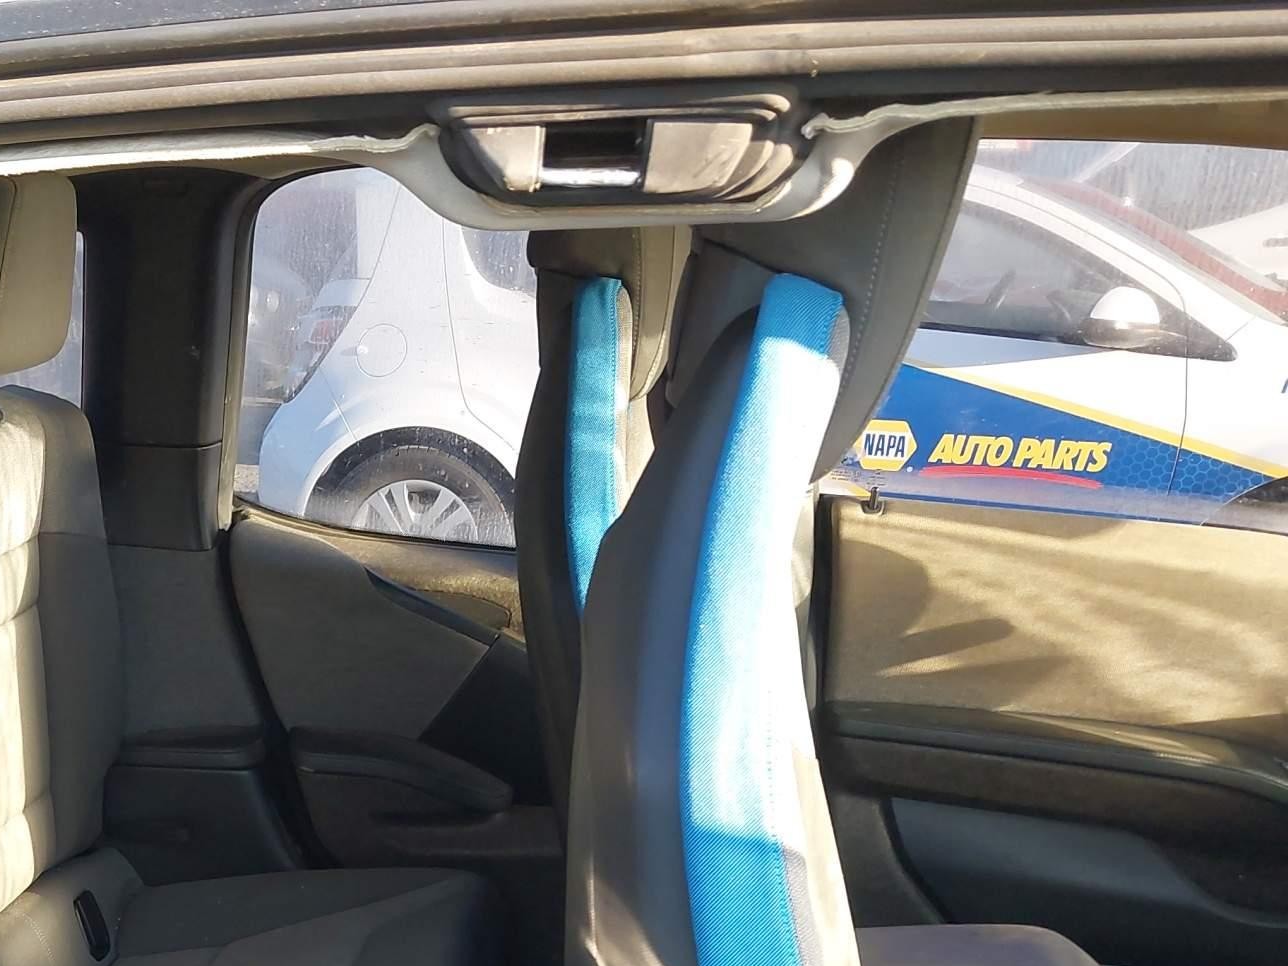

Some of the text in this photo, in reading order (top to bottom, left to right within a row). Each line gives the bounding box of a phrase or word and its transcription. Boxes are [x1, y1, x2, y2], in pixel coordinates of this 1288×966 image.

[863, 433, 906, 458] NAPA
[928, 433, 1112, 473] AUTO PARTS
